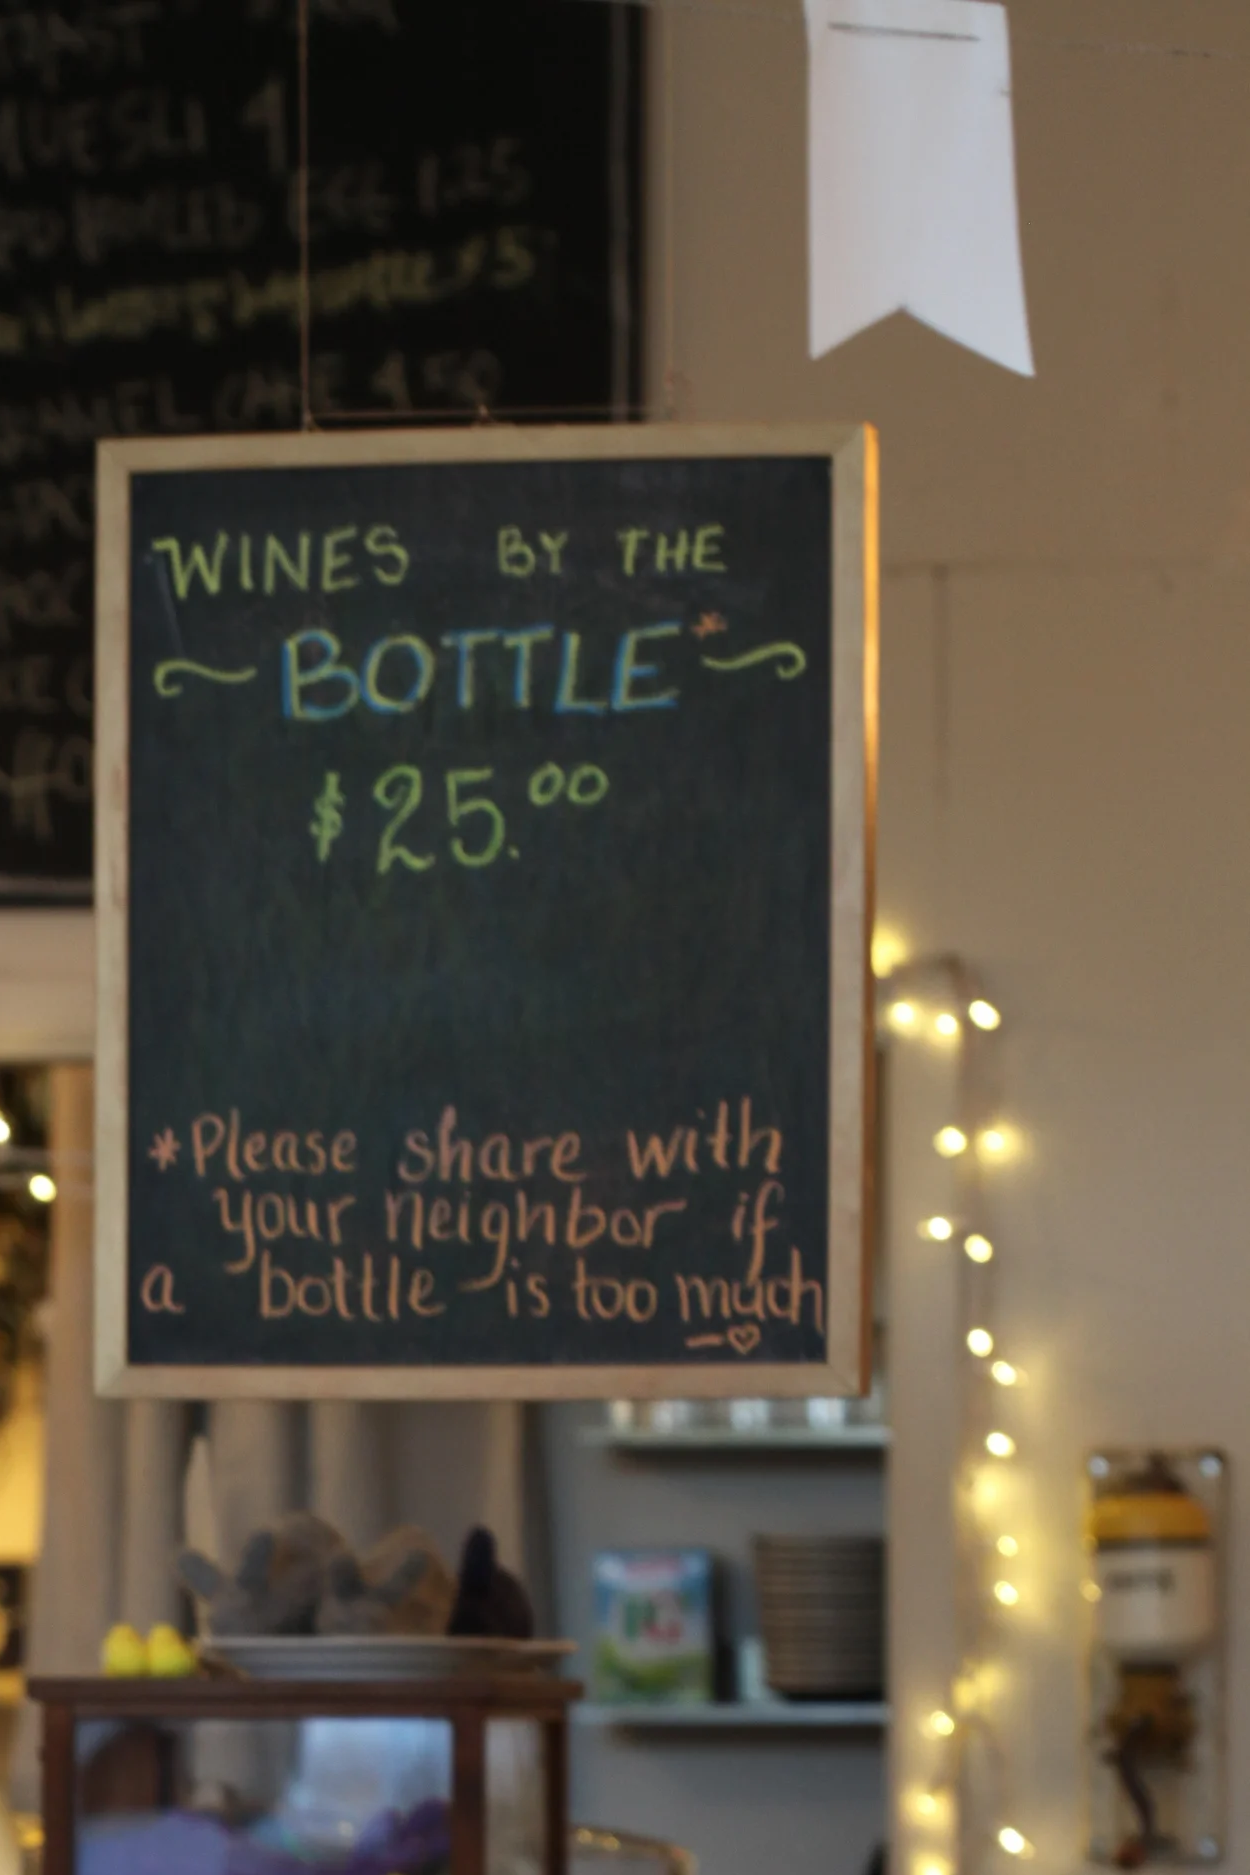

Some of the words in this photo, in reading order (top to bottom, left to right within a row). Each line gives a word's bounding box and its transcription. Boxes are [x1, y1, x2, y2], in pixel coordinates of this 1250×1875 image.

[152, 525, 410, 599] WINES
[498, 526, 568, 577] BY
[618, 525, 727, 577] THE
[398, 1104, 588, 1182] share
[628, 1097, 783, 1179] with
[215, 1186, 357, 1274] your
[385, 1186, 687, 1292] neighbor
[731, 1180, 786, 1282] if
[141, 1264, 185, 1314] a
[258, 1250, 446, 1322] bottle
[506, 1258, 551, 1319] is
[575, 1257, 658, 1322] too
[677, 1247, 826, 1336] much
